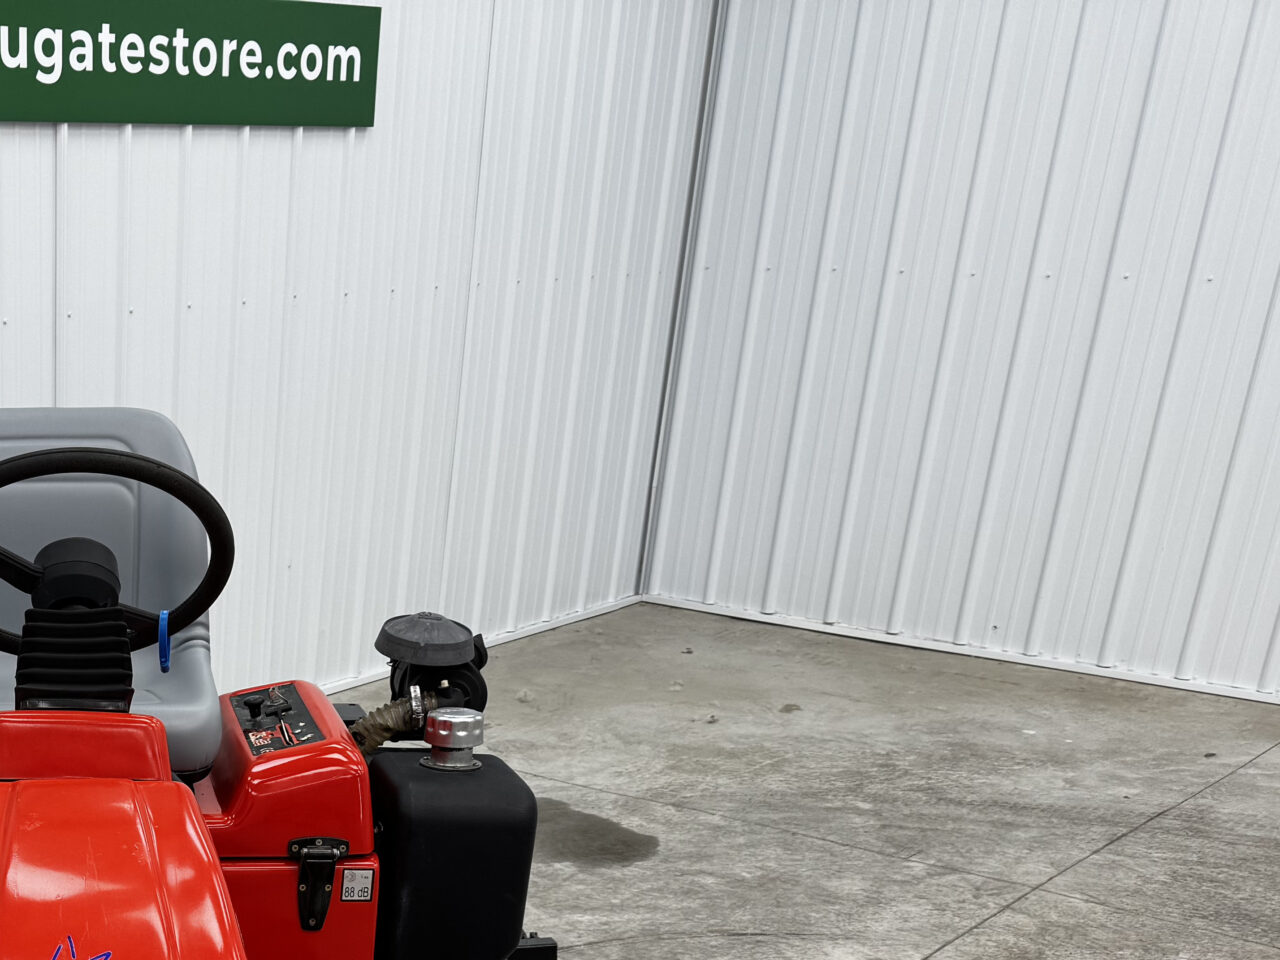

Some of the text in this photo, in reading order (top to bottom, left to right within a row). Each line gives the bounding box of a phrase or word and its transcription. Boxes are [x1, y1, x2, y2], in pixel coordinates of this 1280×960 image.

[0, 23, 361, 84] ugatestore.com
[344, 886, 369, 898] 88 dB
